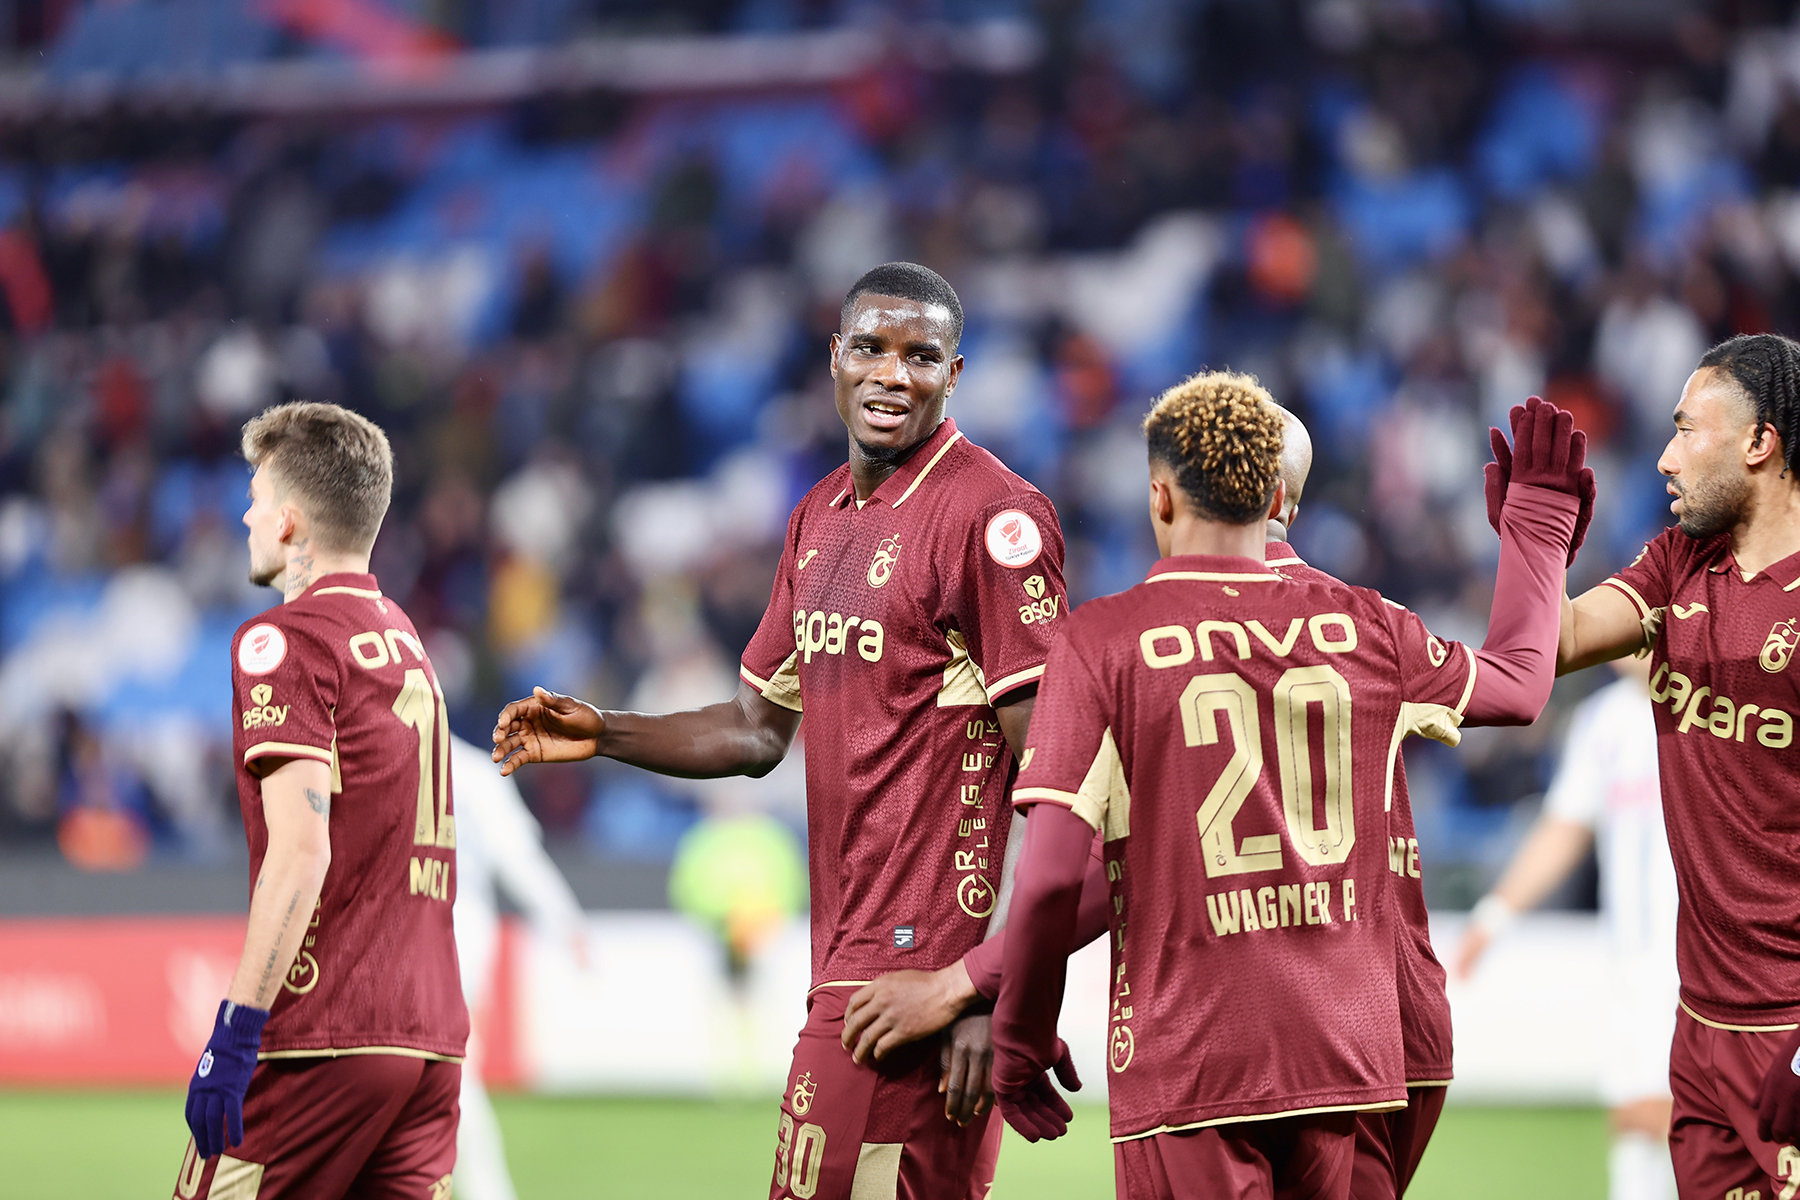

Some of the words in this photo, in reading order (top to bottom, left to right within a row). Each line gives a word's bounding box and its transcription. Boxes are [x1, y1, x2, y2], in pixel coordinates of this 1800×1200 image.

[792, 609, 885, 663] apara
[1018, 594, 1060, 625] asoy
[242, 704, 288, 731] asoy
[1178, 664, 1356, 879] 20
[1206, 881, 1332, 937] WAGNER
[1342, 879, 1357, 922] P.
